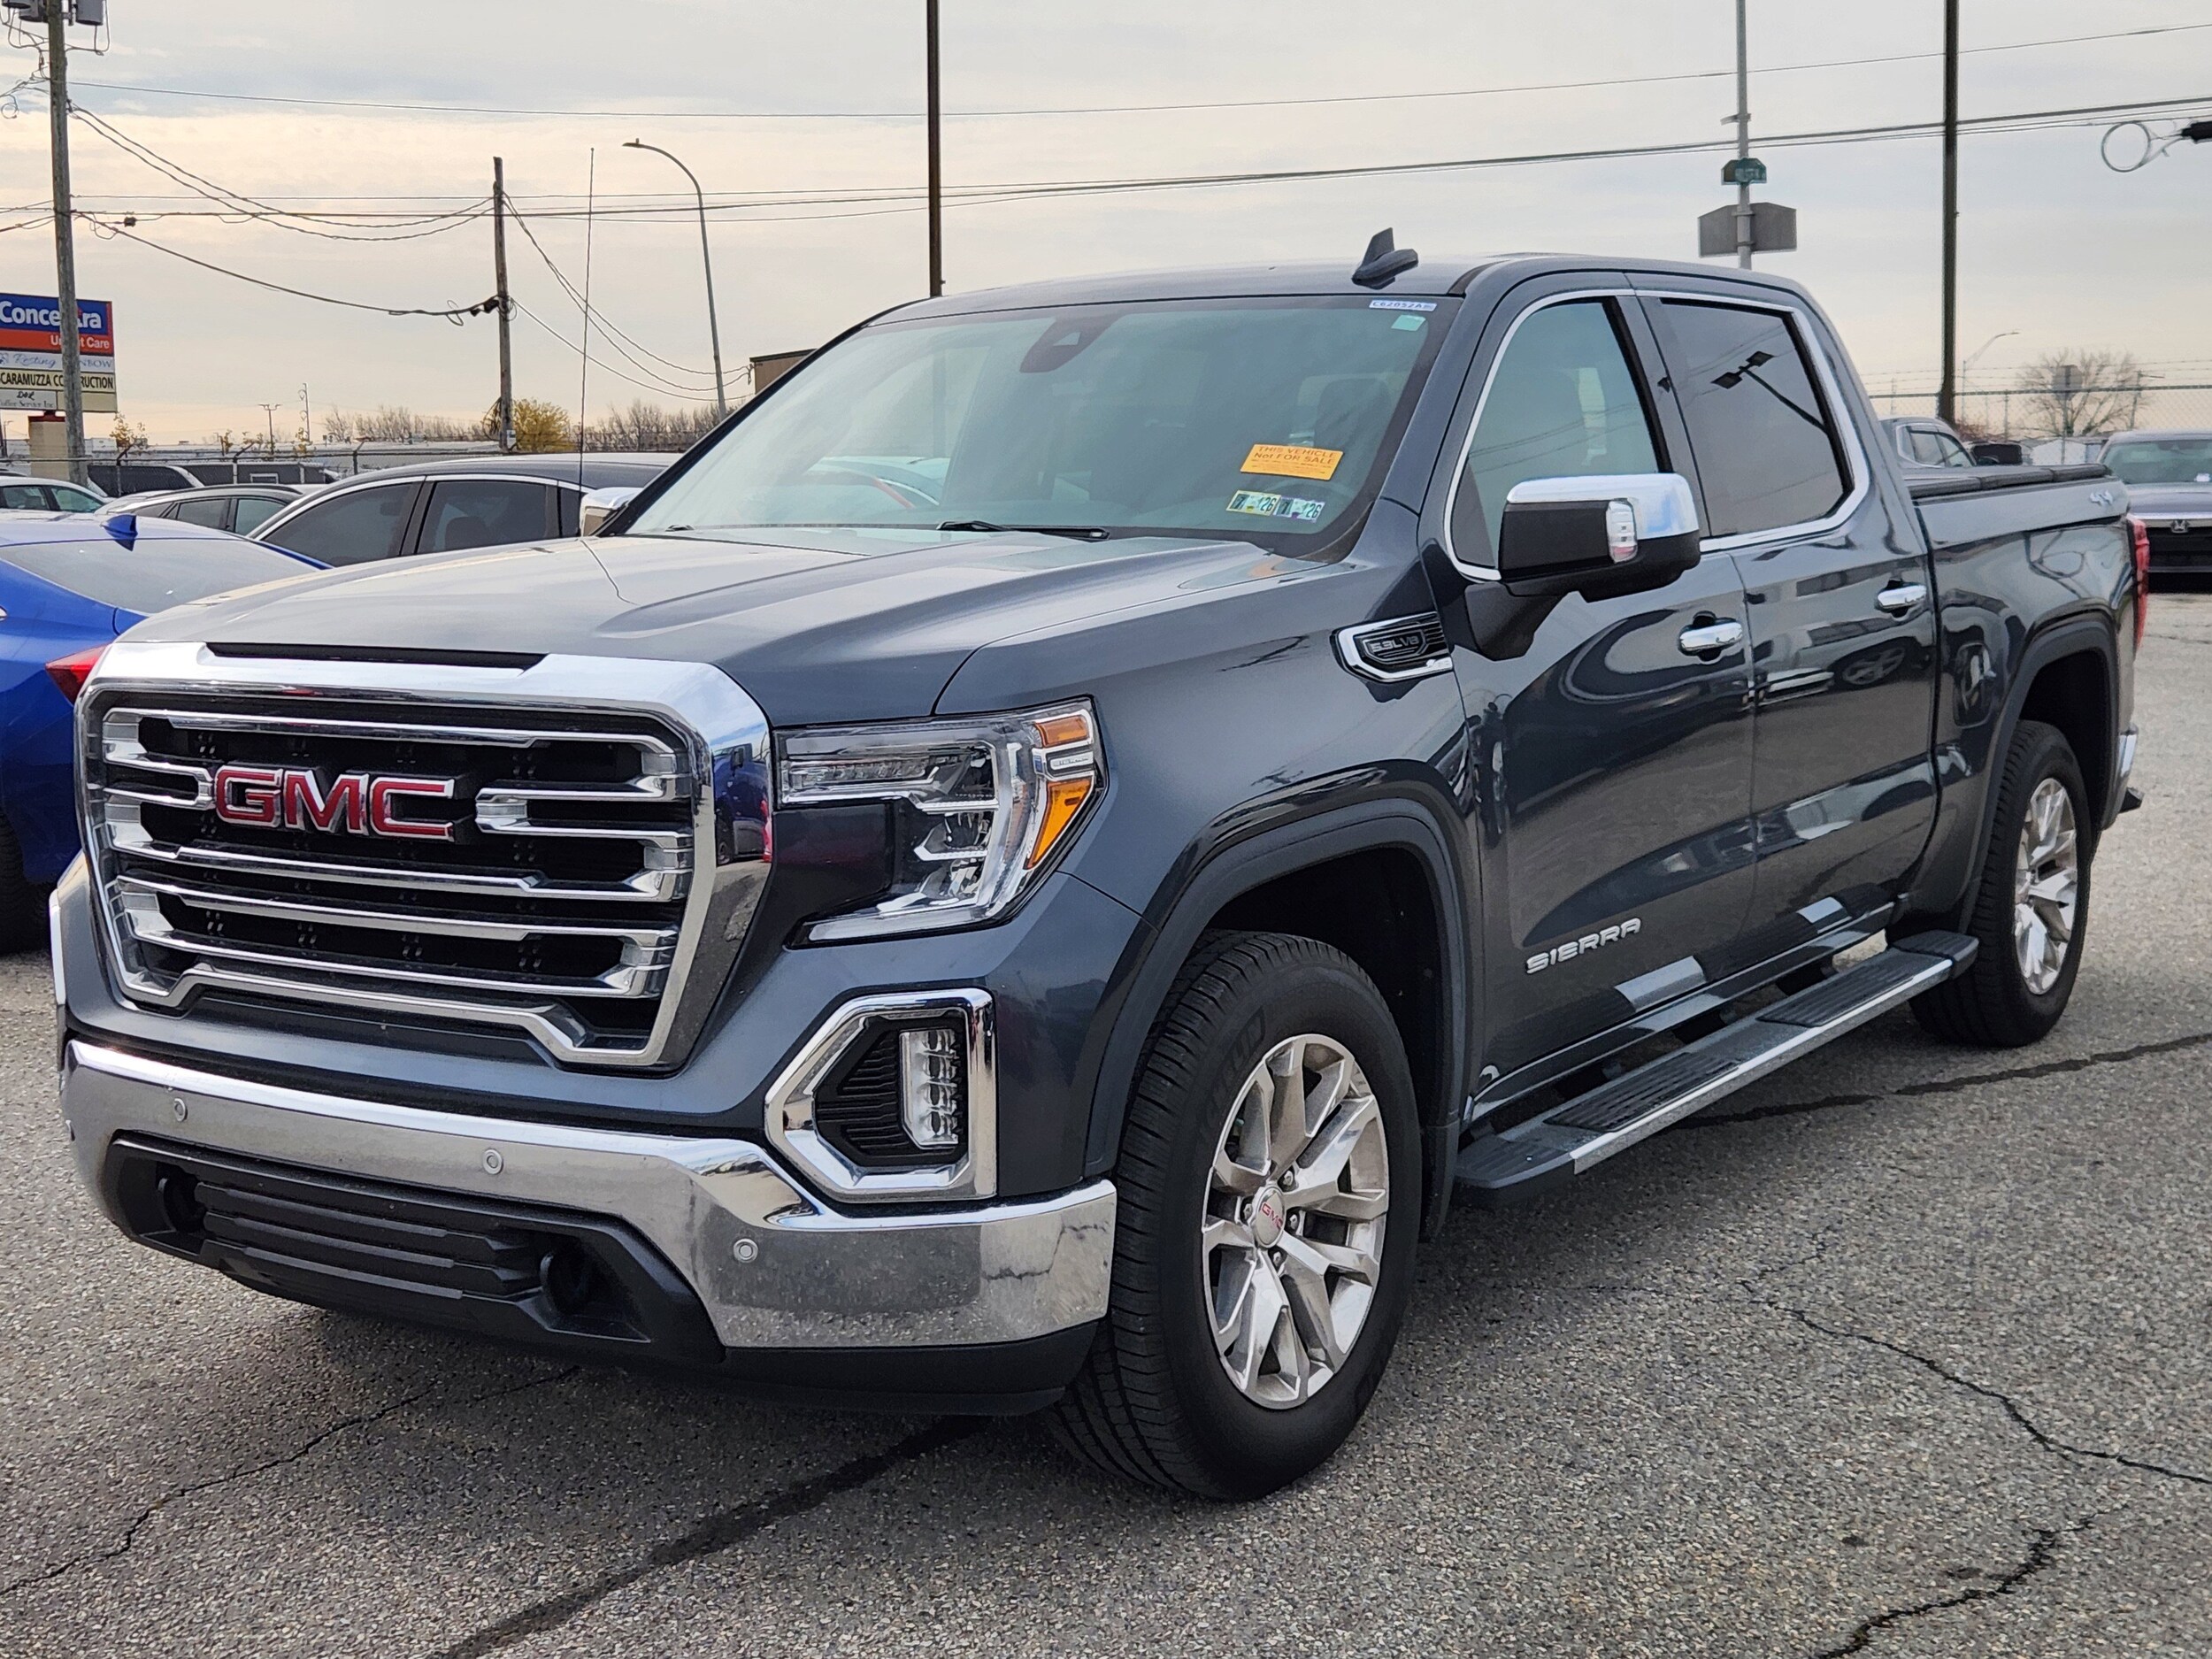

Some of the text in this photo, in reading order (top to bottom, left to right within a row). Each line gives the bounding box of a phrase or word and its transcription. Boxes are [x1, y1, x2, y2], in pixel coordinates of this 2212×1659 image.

[0, 301, 102, 329] Concera
[87, 337, 110, 349] Care
[0, 373, 113, 388] CARAMUZZA CORUCTION
[1288, 448, 1336, 457] VEHICLE
[215, 764, 454, 841] GMC
[1526, 918, 1641, 974] SIERRA
[1262, 1202, 1283, 1231] GMC
